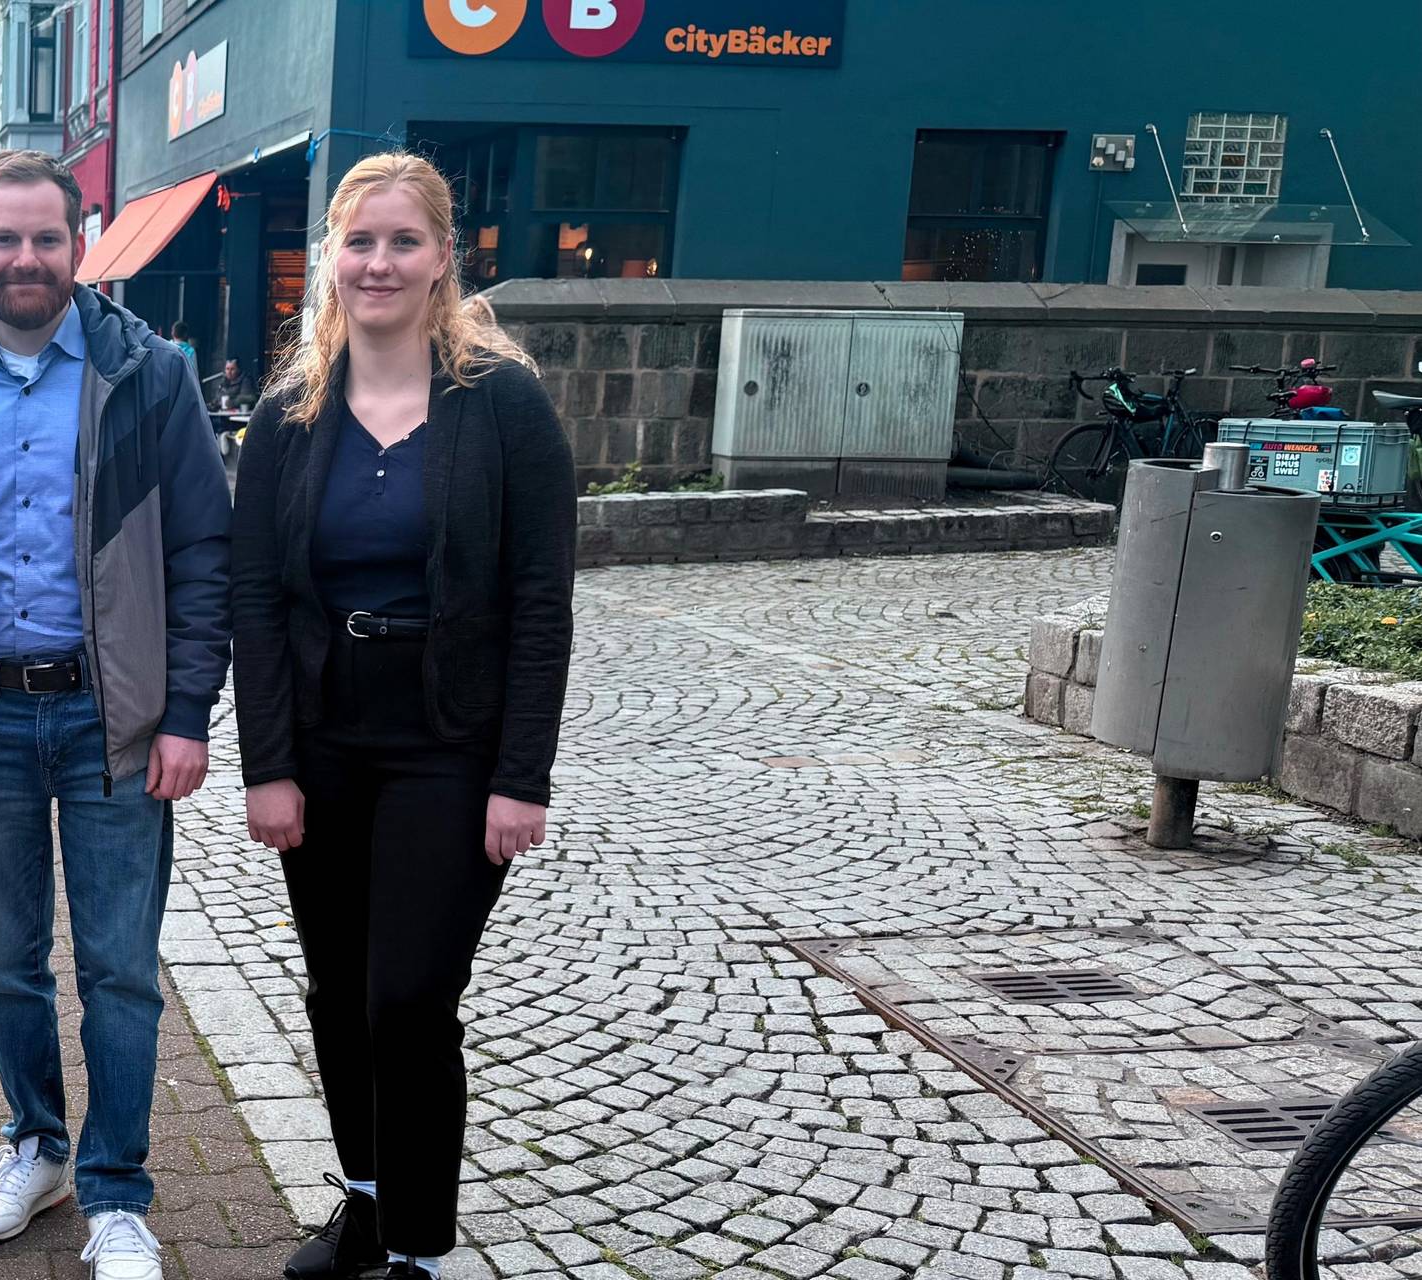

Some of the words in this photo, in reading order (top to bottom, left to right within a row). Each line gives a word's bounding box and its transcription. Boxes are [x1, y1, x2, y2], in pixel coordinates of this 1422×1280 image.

[449, 0, 497, 28] C
[569, 0, 617, 30] B
[665, 24, 832, 58] CityBäcker
[1263, 443, 1283, 451] AUTO
[1283, 444, 1319, 452] WENIGER.
[1276, 453, 1300, 461] DIEAF
